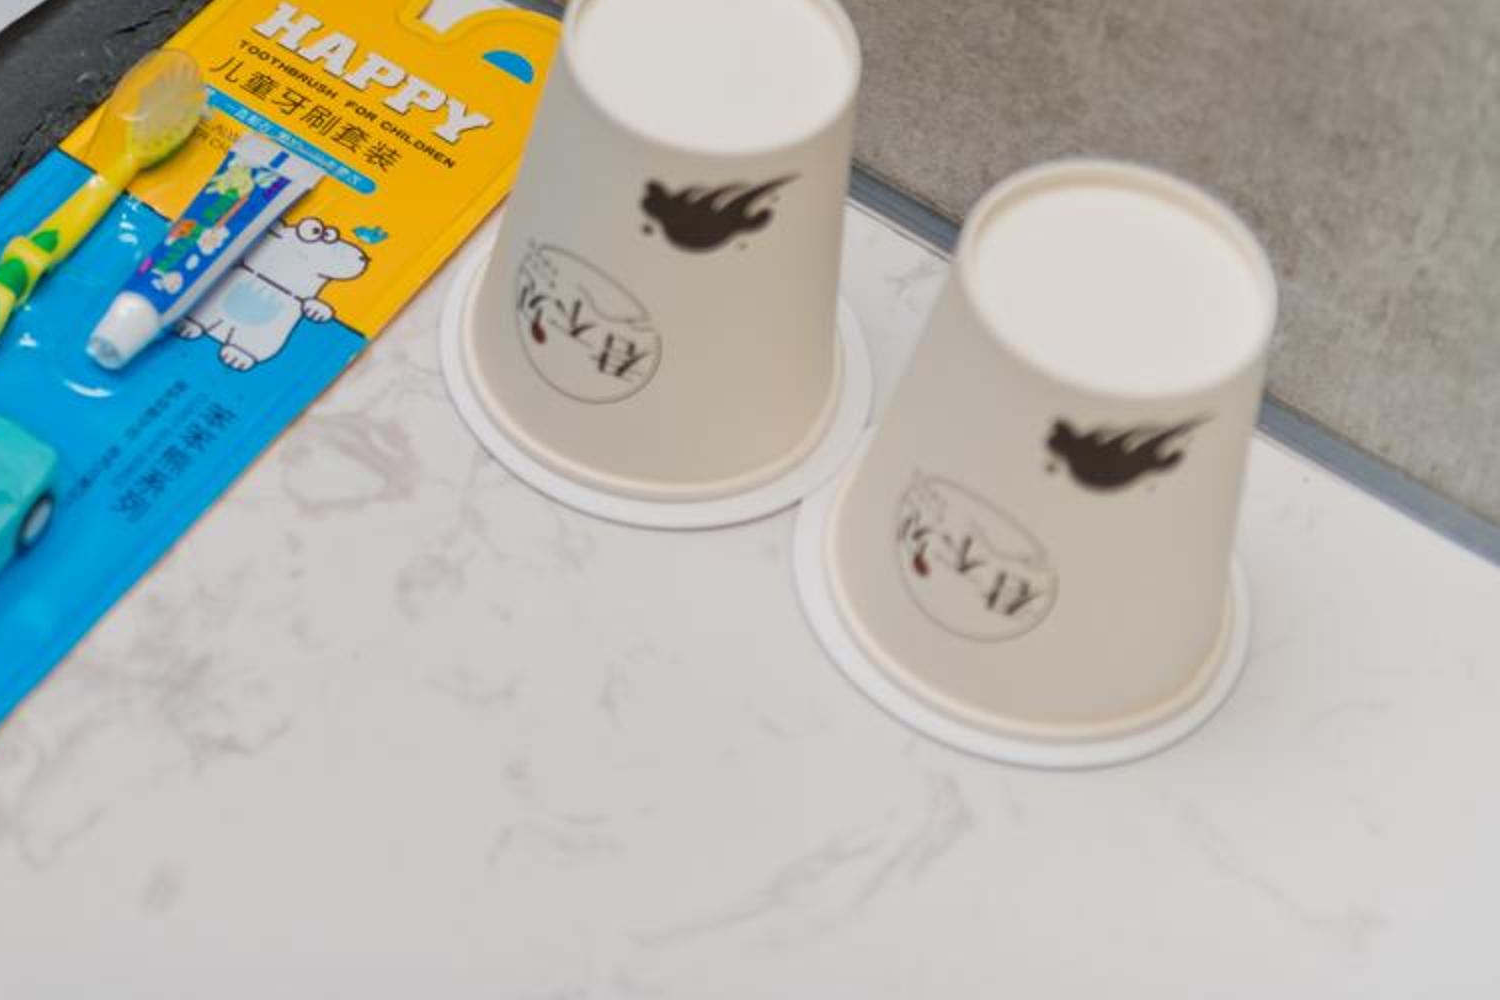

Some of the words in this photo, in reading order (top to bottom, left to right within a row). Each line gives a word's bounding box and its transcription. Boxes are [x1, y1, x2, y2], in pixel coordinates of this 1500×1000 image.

[209, 55, 404, 174] 儿童牙刷套装
[238, 39, 339, 101] TOOTHBRUSH
[344, 99, 379, 124] FOR
[380, 119, 457, 170] CHILDREN
[251, 0, 493, 145] HAPPY
